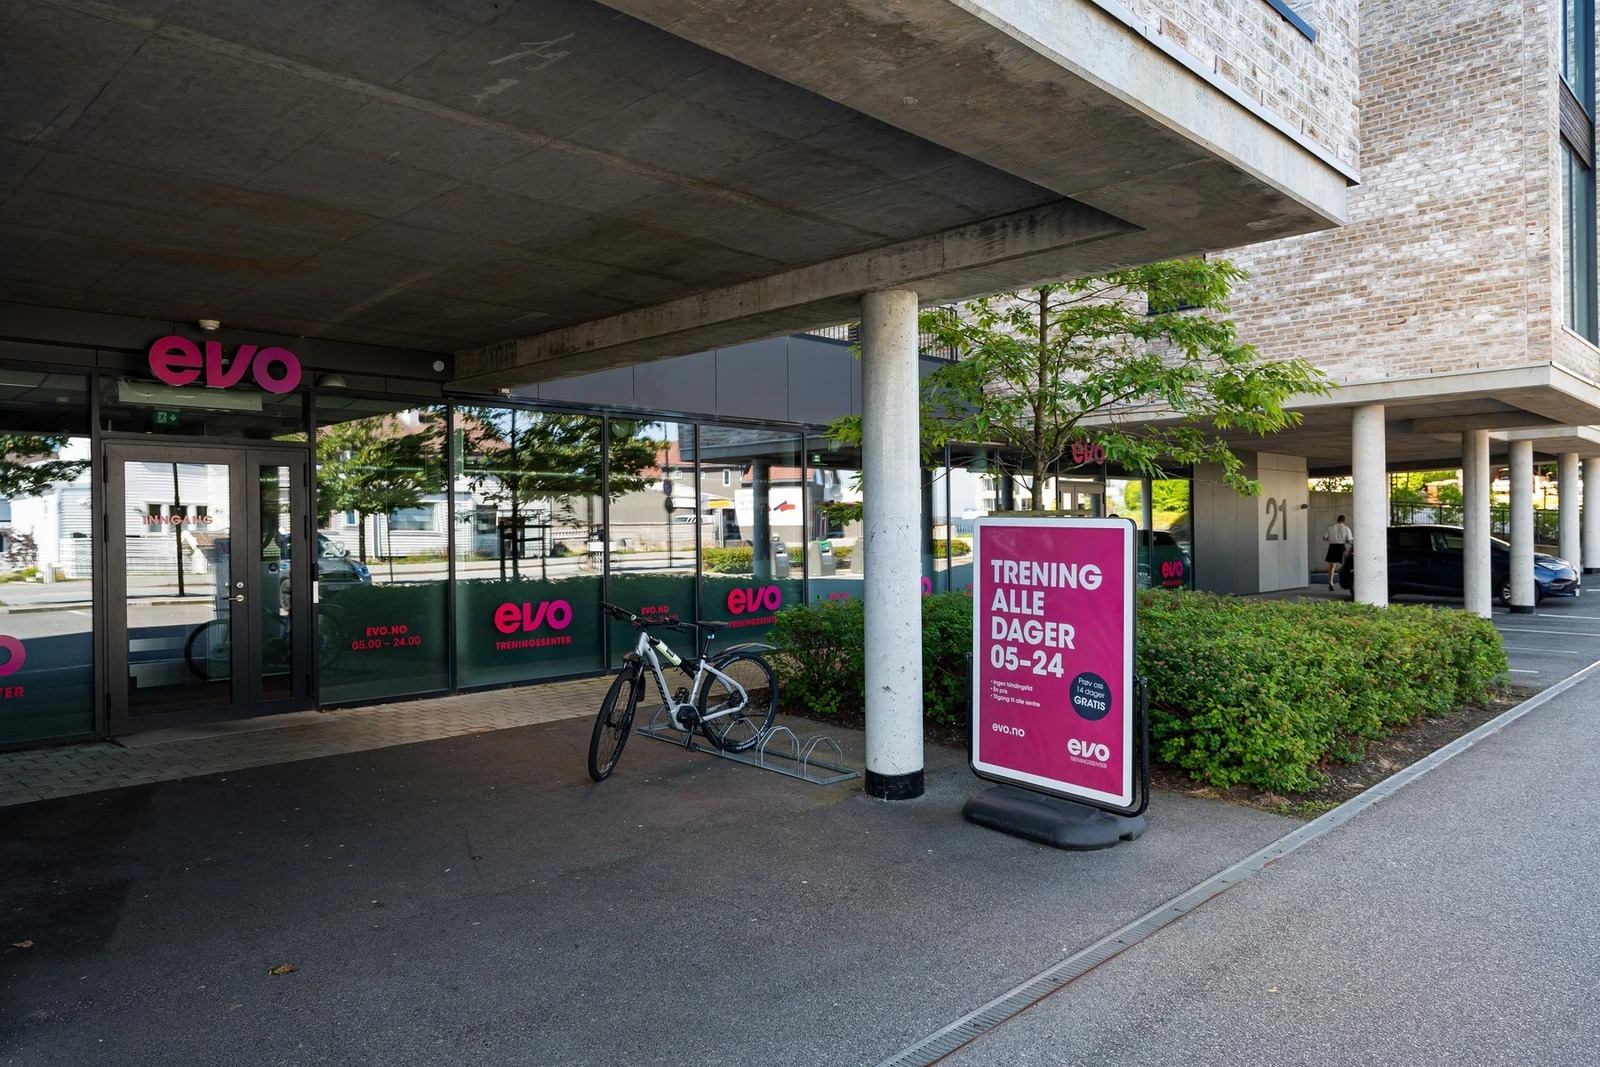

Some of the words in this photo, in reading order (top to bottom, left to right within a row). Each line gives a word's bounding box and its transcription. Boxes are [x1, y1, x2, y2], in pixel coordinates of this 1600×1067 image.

[149, 335, 302, 394] evo
[143, 515, 213, 525] INNGANG
[1265, 497, 1287, 541] 21
[991, 559, 1103, 591] TRENING
[1161, 560, 1184, 578] evo
[727, 585, 782, 615] evo
[991, 588, 1045, 616] ALLE
[494, 600, 573, 633] evo
[366, 625, 408, 637] EVO.NO
[991, 615, 1076, 650] DAGER
[352, 639, 381, 650] 05.00
[393, 636, 421, 647] 24.00
[495, 635, 572, 651] TRENINGSSENTER
[1006, 682, 1033, 691] bindingstid
[1078, 677, 1093, 686] Prøv
[1093, 682, 1104, 690] oss
[1076, 685, 1084, 693] 14
[1084, 689, 1105, 699] dager
[993, 693, 1010, 703] Tilgang
[1025, 700, 1041, 708] sentre
[1073, 695, 1106, 711] GRATIS
[992, 723, 1025, 737] evo.no
[1067, 738, 1110, 762] evo
